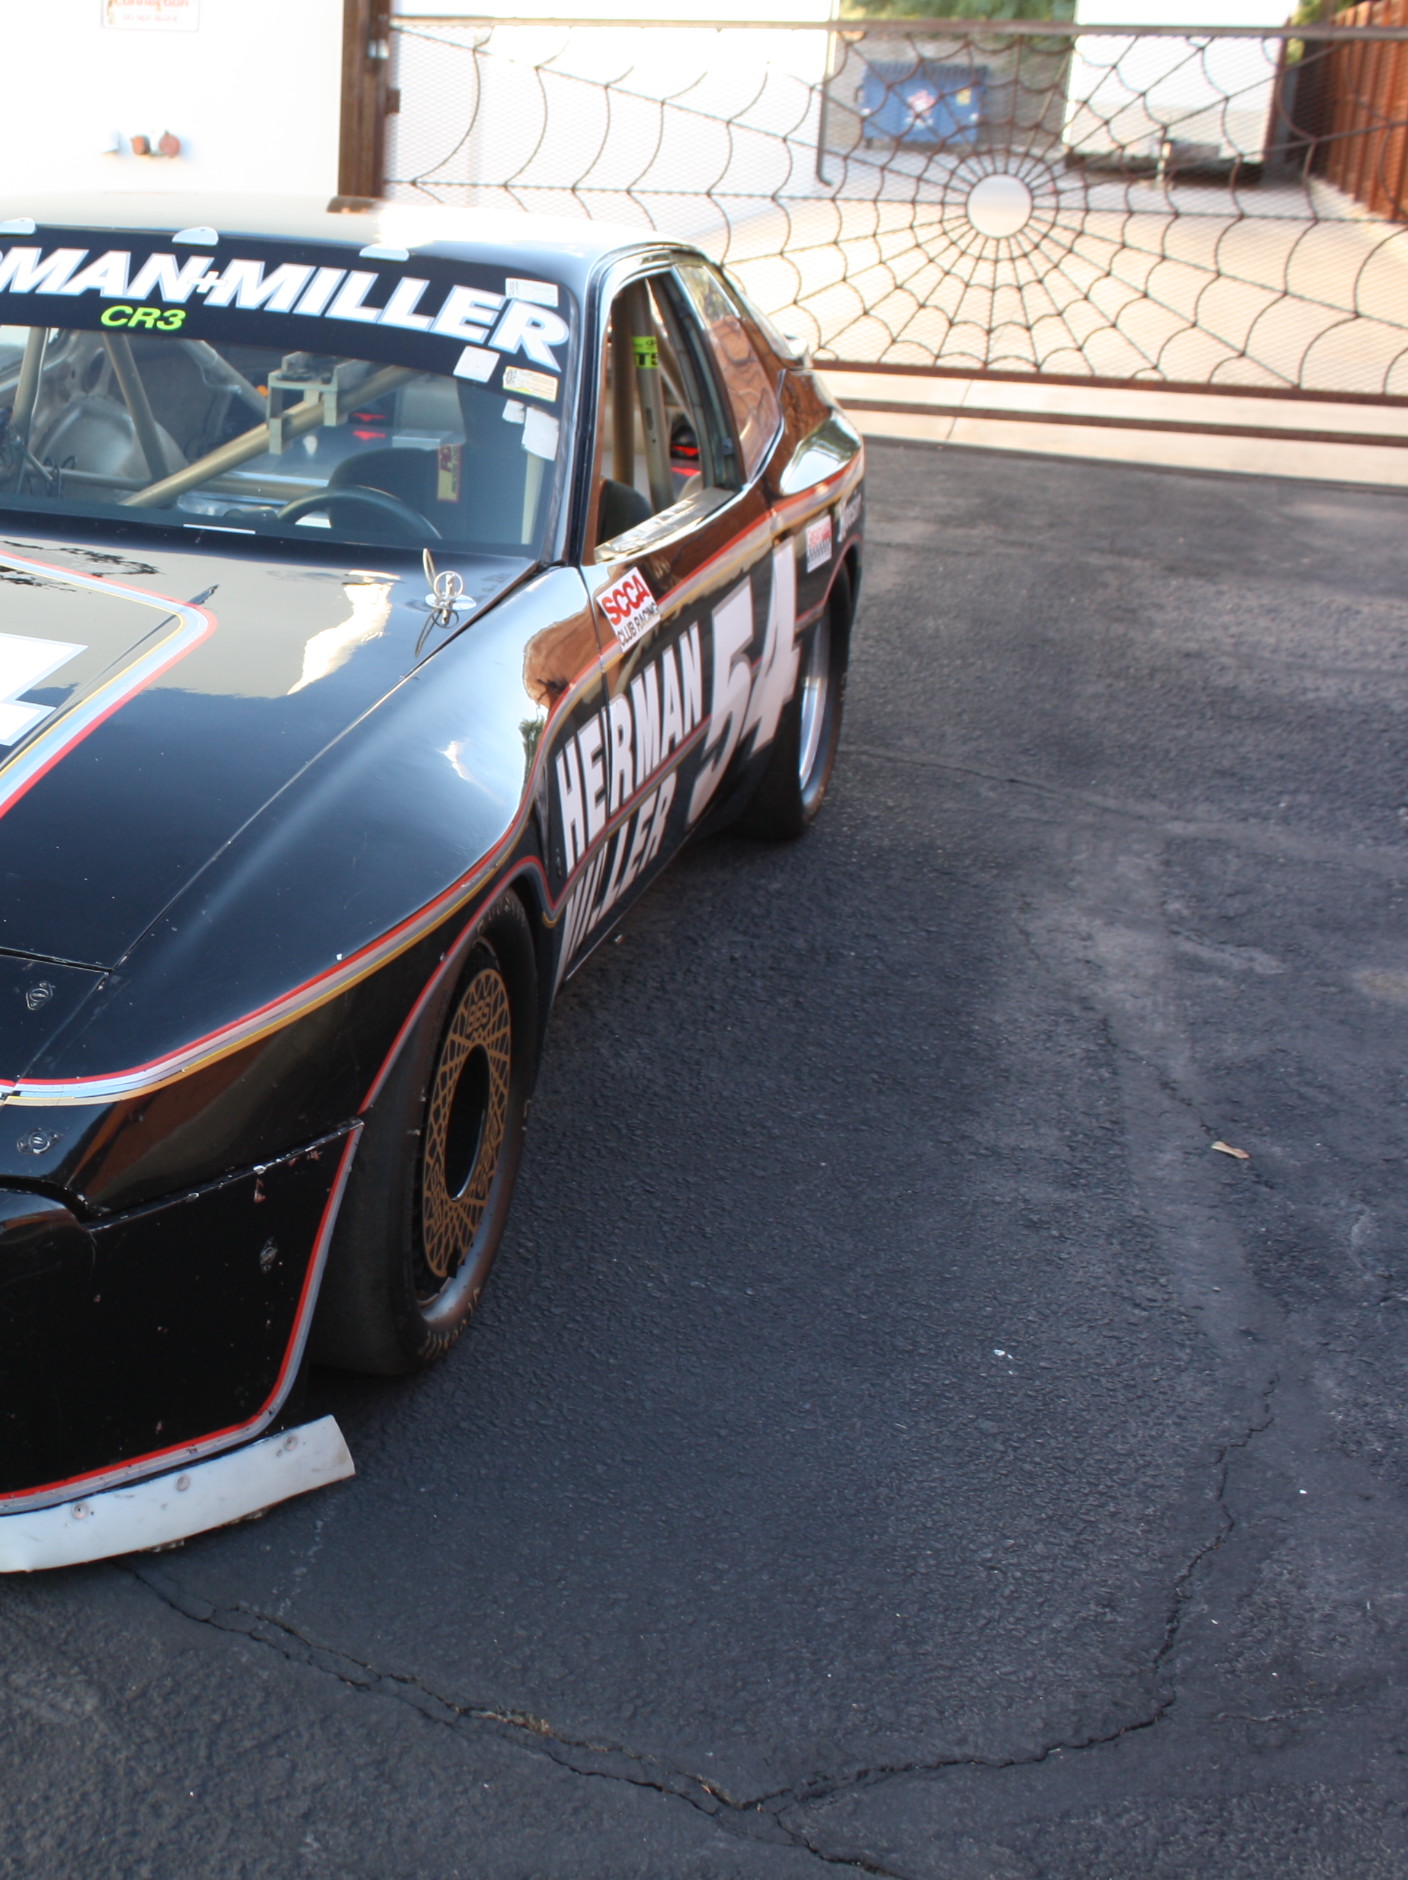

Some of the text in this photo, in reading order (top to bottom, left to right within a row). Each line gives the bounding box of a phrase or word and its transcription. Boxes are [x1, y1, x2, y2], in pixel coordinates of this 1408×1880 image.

[101, 304, 186, 331] CR3
[601, 574, 650, 625] SCCA
[617, 621, 637, 646] CLUB
[685, 537, 802, 827] 54
[555, 620, 703, 878] HERMAN
